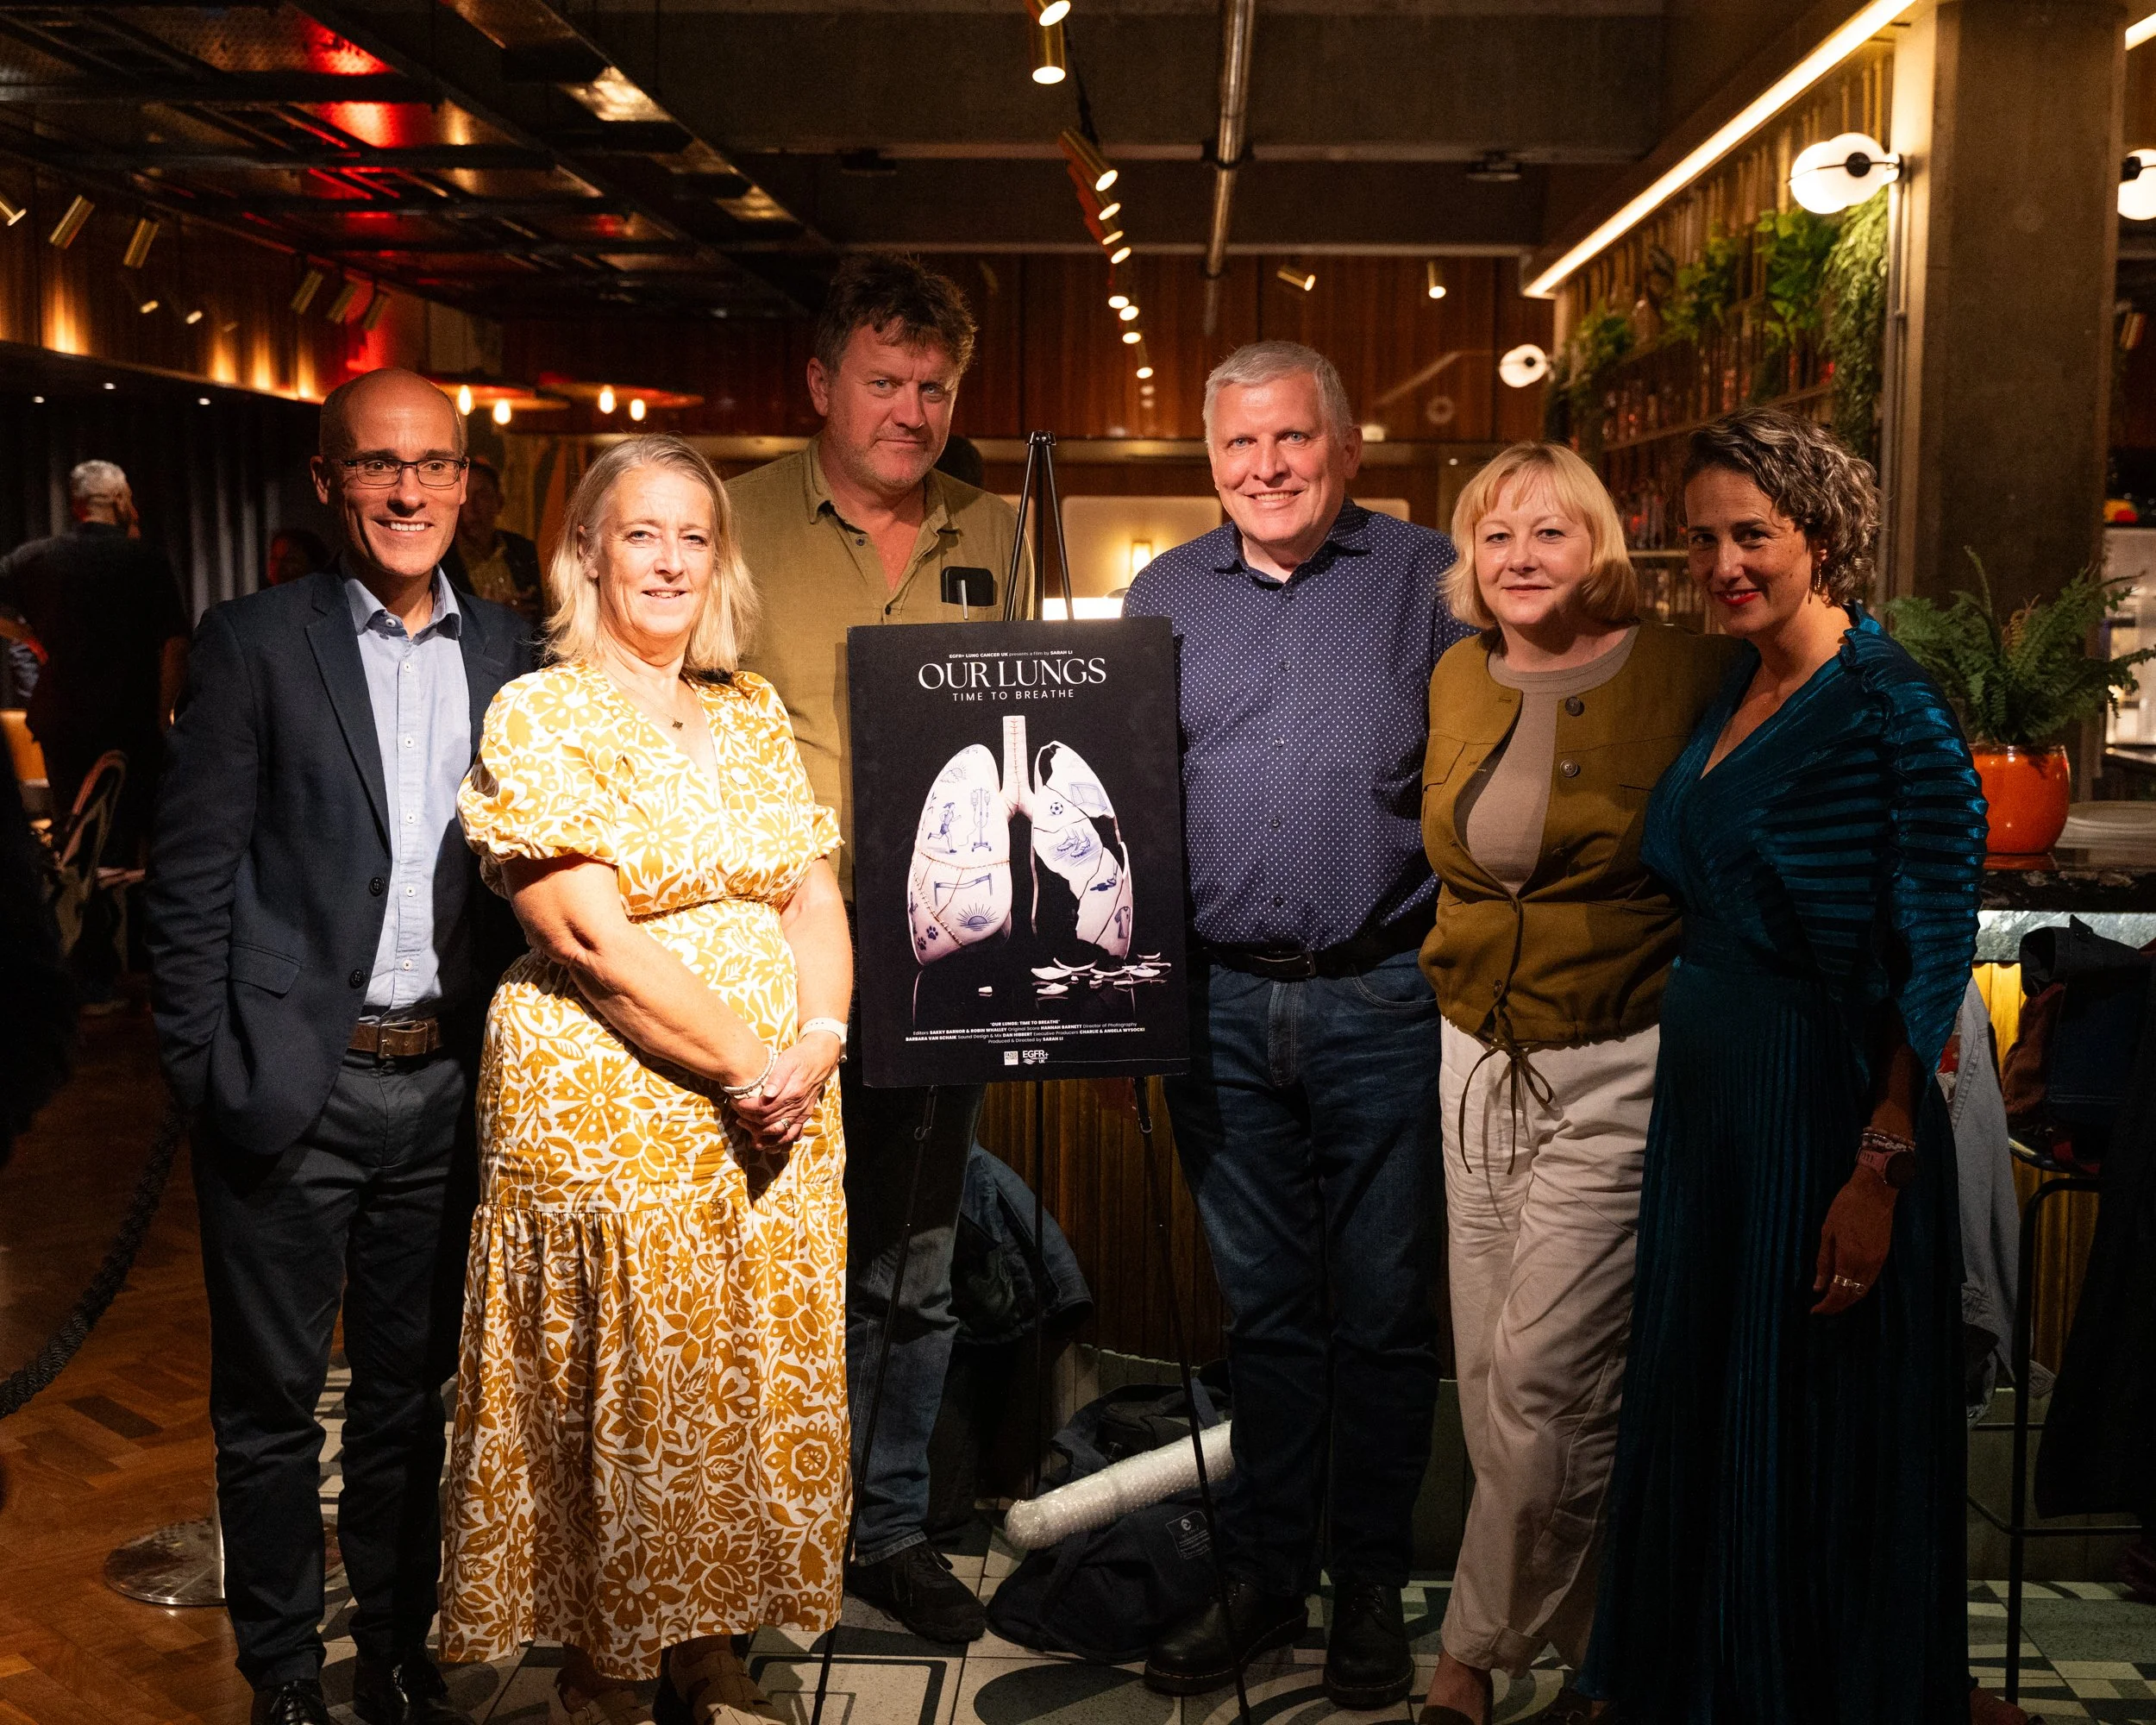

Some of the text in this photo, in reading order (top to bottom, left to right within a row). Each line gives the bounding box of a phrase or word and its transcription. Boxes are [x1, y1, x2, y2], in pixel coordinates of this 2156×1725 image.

[918, 658, 1106, 690] OUR LUNGS
[953, 689, 1074, 701] TIME TO BREATHE
[1023, 1050, 1049, 1058] EGFR+
